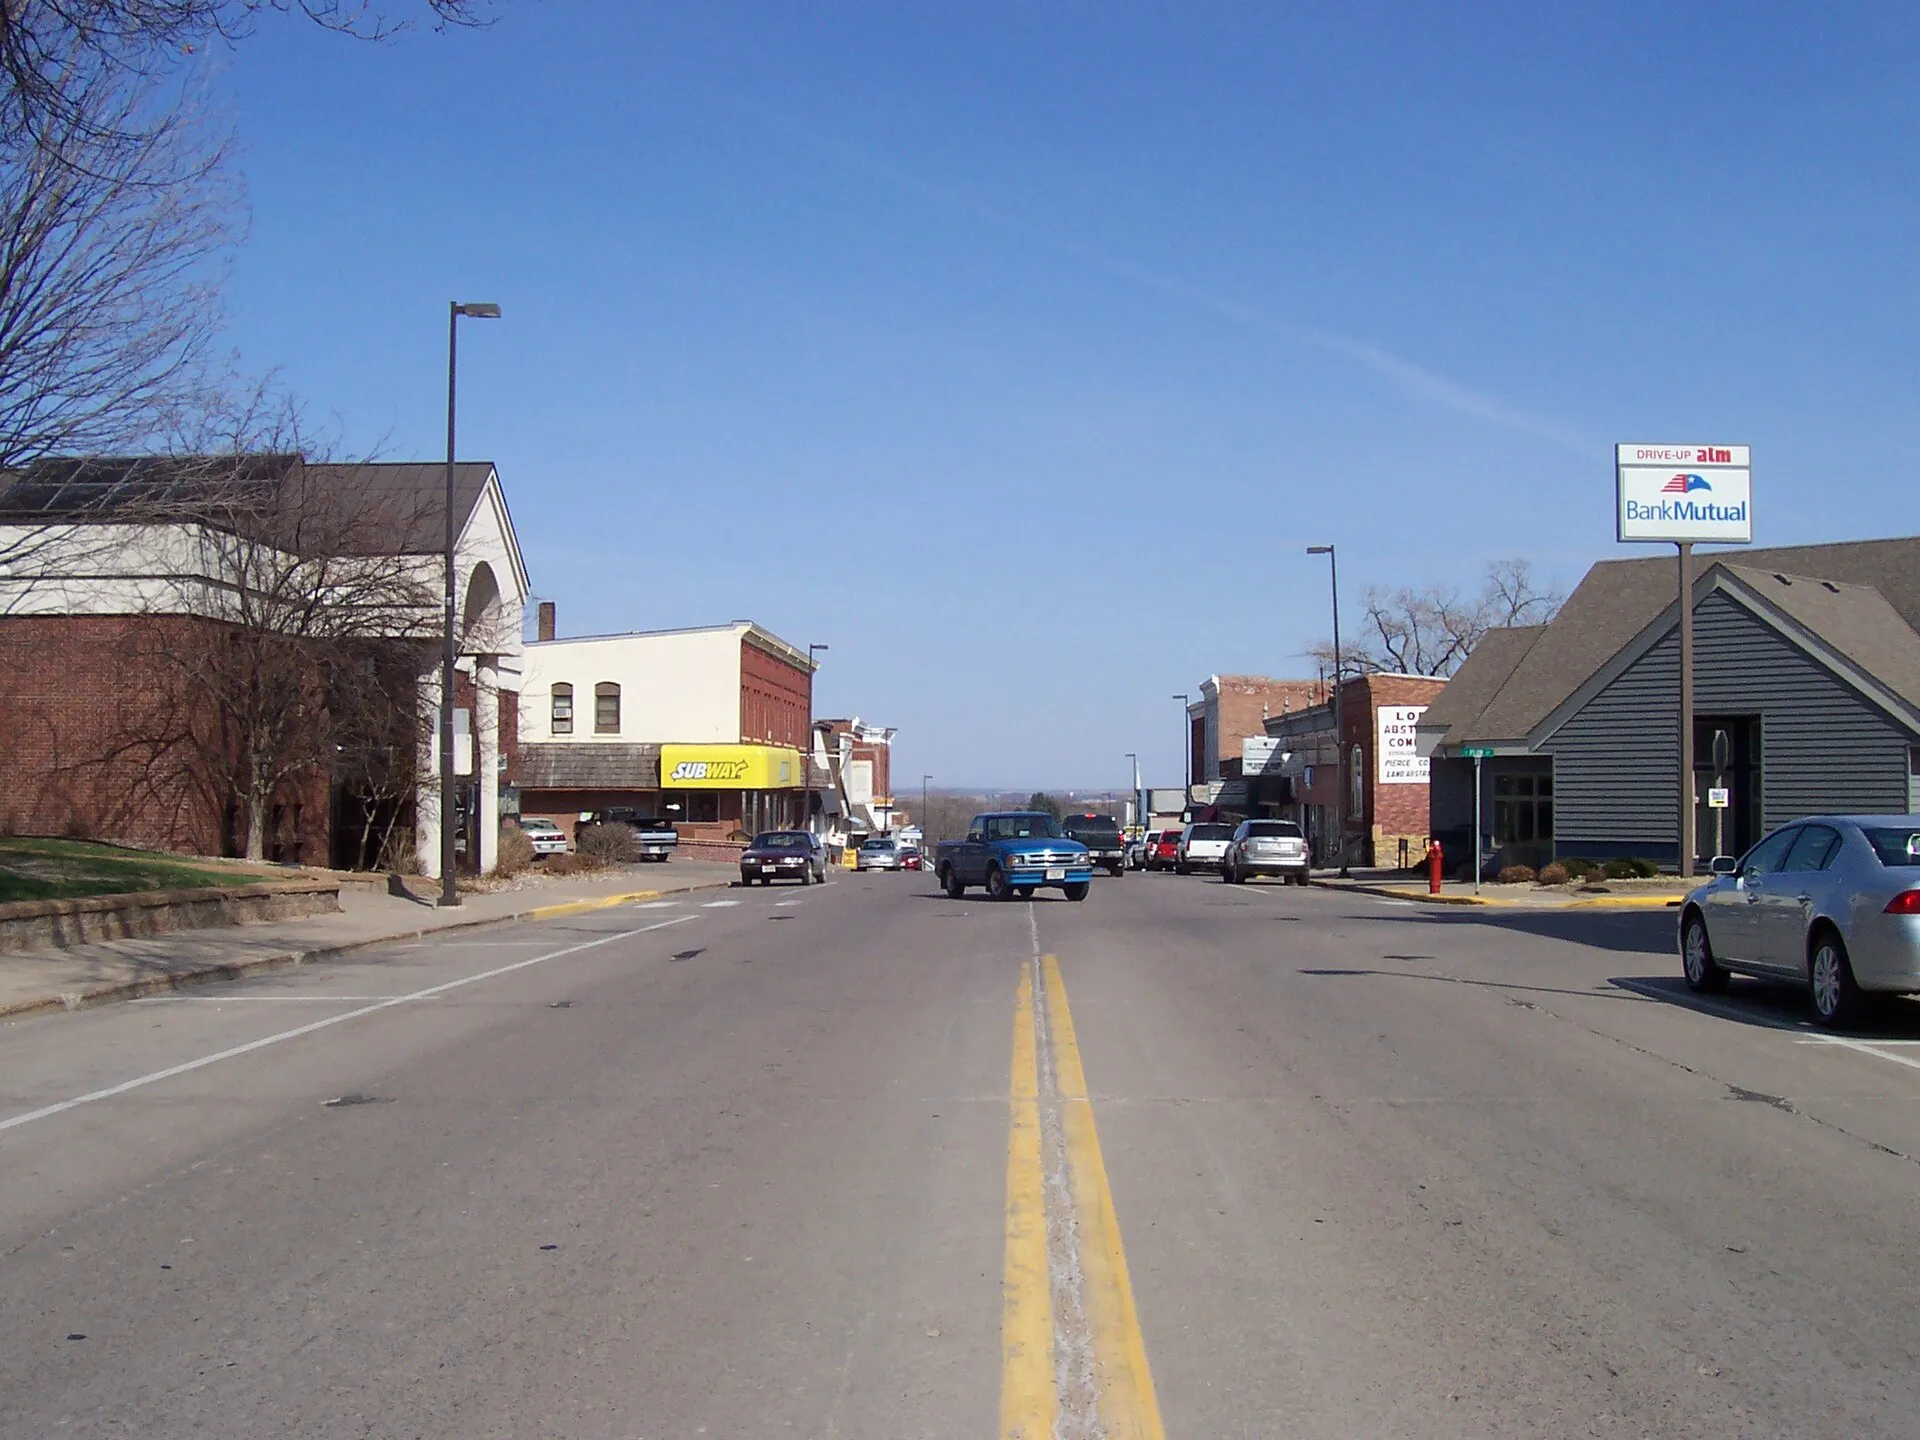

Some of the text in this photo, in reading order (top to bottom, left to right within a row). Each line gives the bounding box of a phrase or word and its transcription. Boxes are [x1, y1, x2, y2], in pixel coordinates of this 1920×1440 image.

[1636, 447, 1732, 463] DRIVE-UP atm
[1626, 500, 1746, 521] BankMutual
[1389, 738, 1417, 747] COM
[671, 759, 748, 781] SUBWAY
